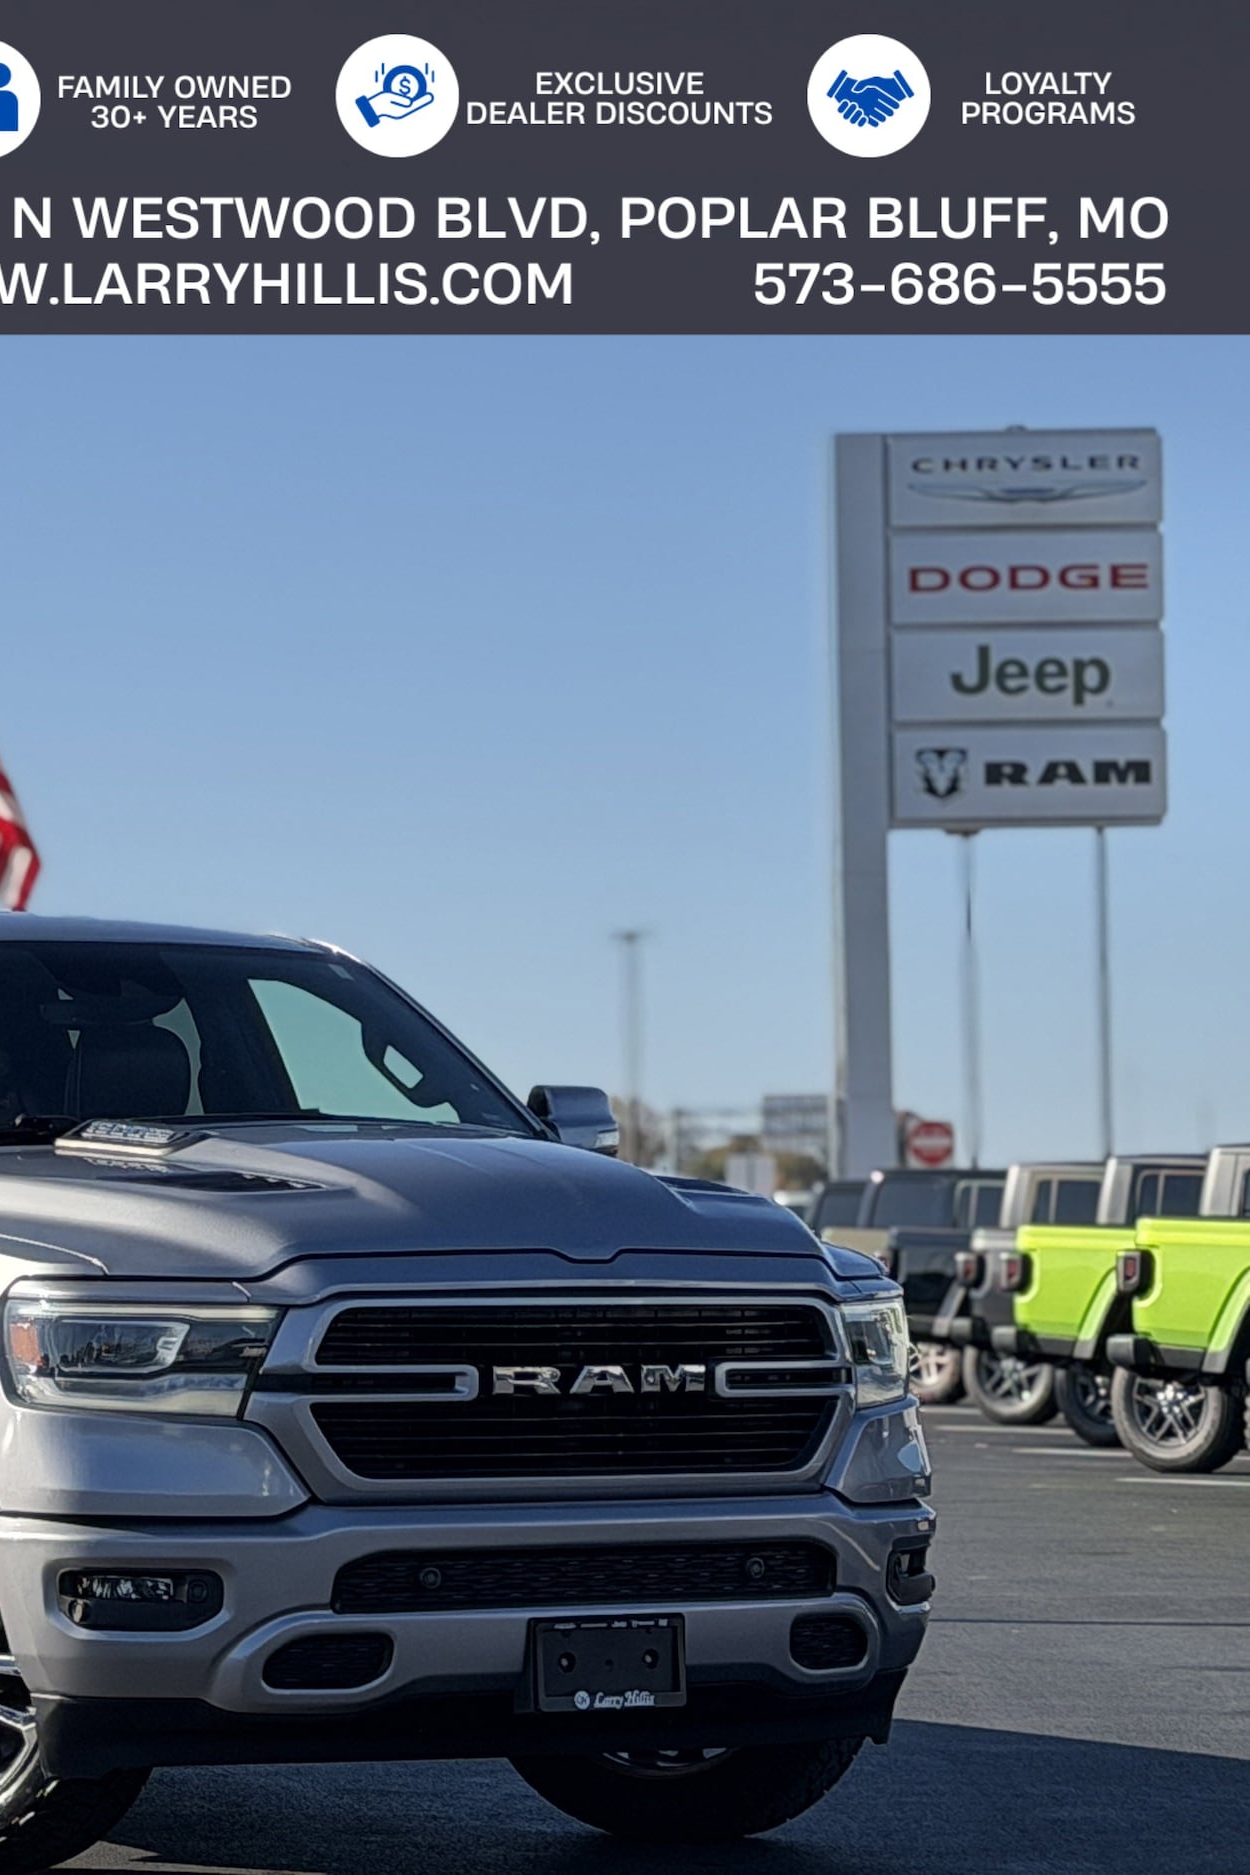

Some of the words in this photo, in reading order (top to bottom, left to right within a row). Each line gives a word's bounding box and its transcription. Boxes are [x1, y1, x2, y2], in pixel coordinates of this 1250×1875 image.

[911, 454, 1141, 475] CHRYSLER
[909, 563, 1150, 593] DODGE
[950, 644, 1112, 706] Jeep
[984, 759, 1152, 787] RAM
[491, 1363, 707, 1396] RAM
